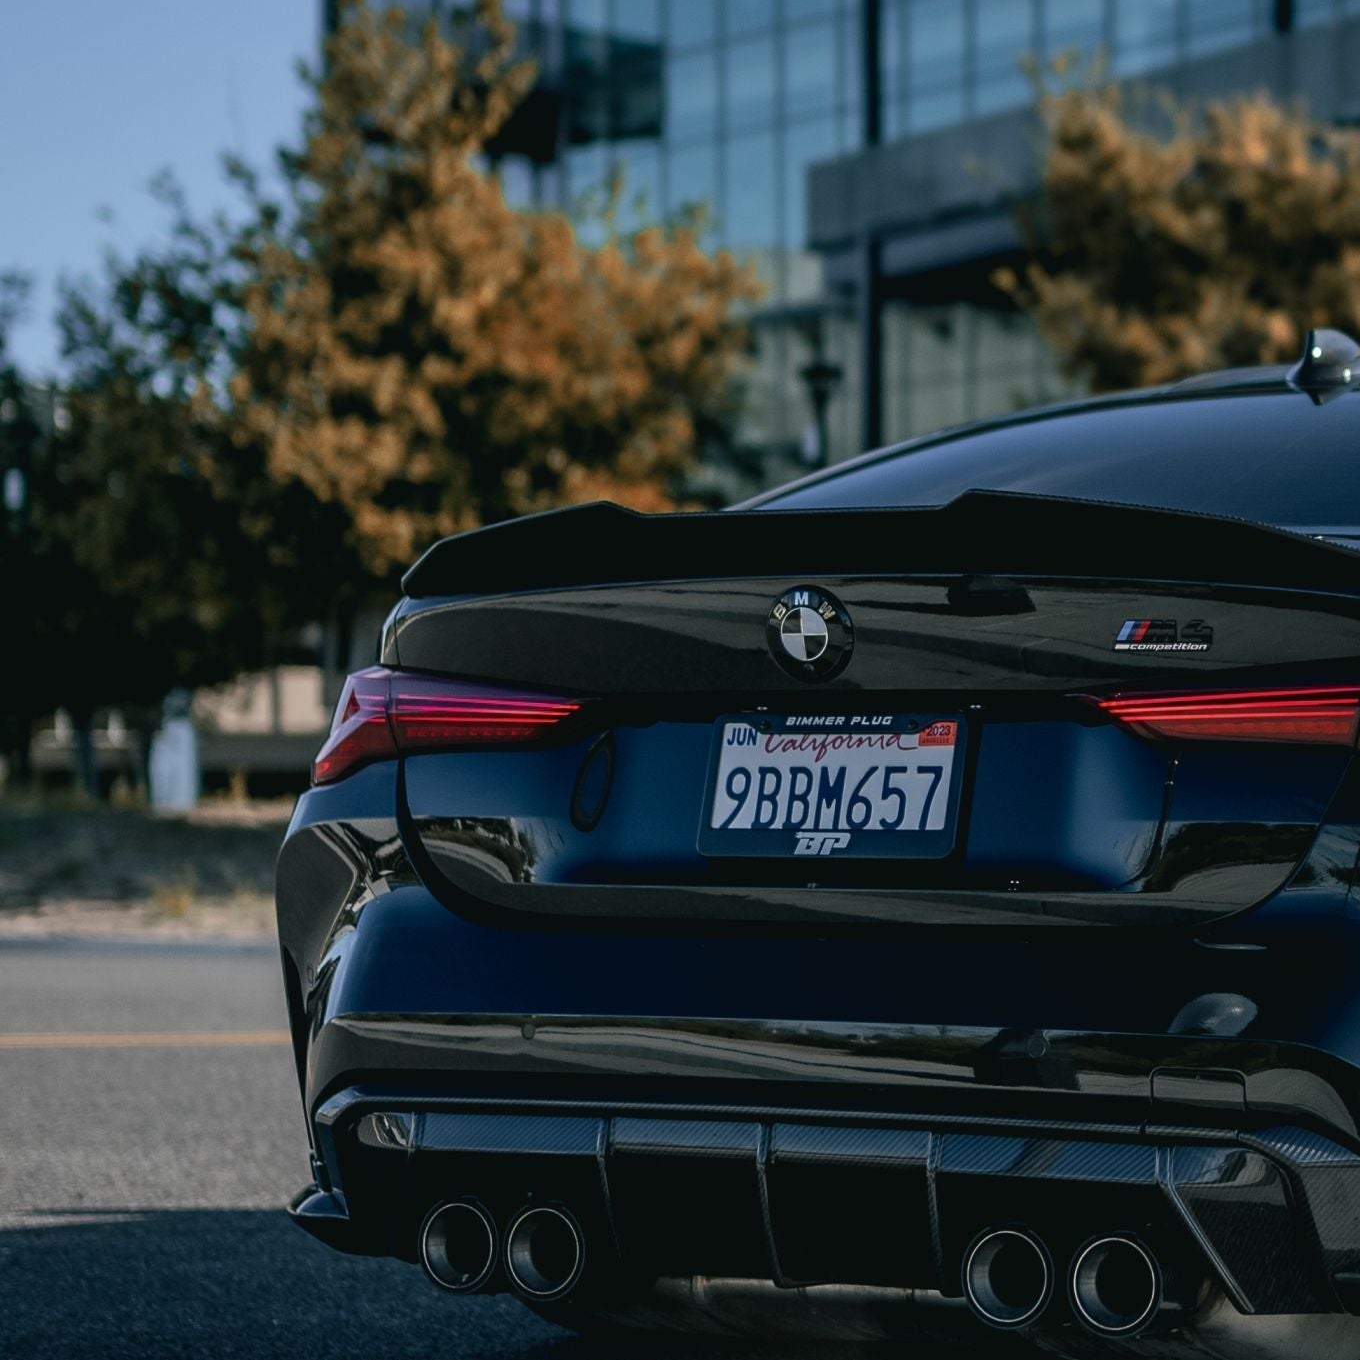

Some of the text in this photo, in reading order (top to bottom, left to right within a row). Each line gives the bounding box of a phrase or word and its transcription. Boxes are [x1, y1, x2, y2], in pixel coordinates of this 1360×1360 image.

[773, 591, 837, 620] BMW
[1130, 642, 1208, 651] competition
[786, 716, 893, 726] BIMMER PLUG
[927, 725, 951, 736] 2023
[727, 727, 757, 746] JUN
[719, 766, 943, 830] 9BBM657
[794, 832, 851, 855] BP
